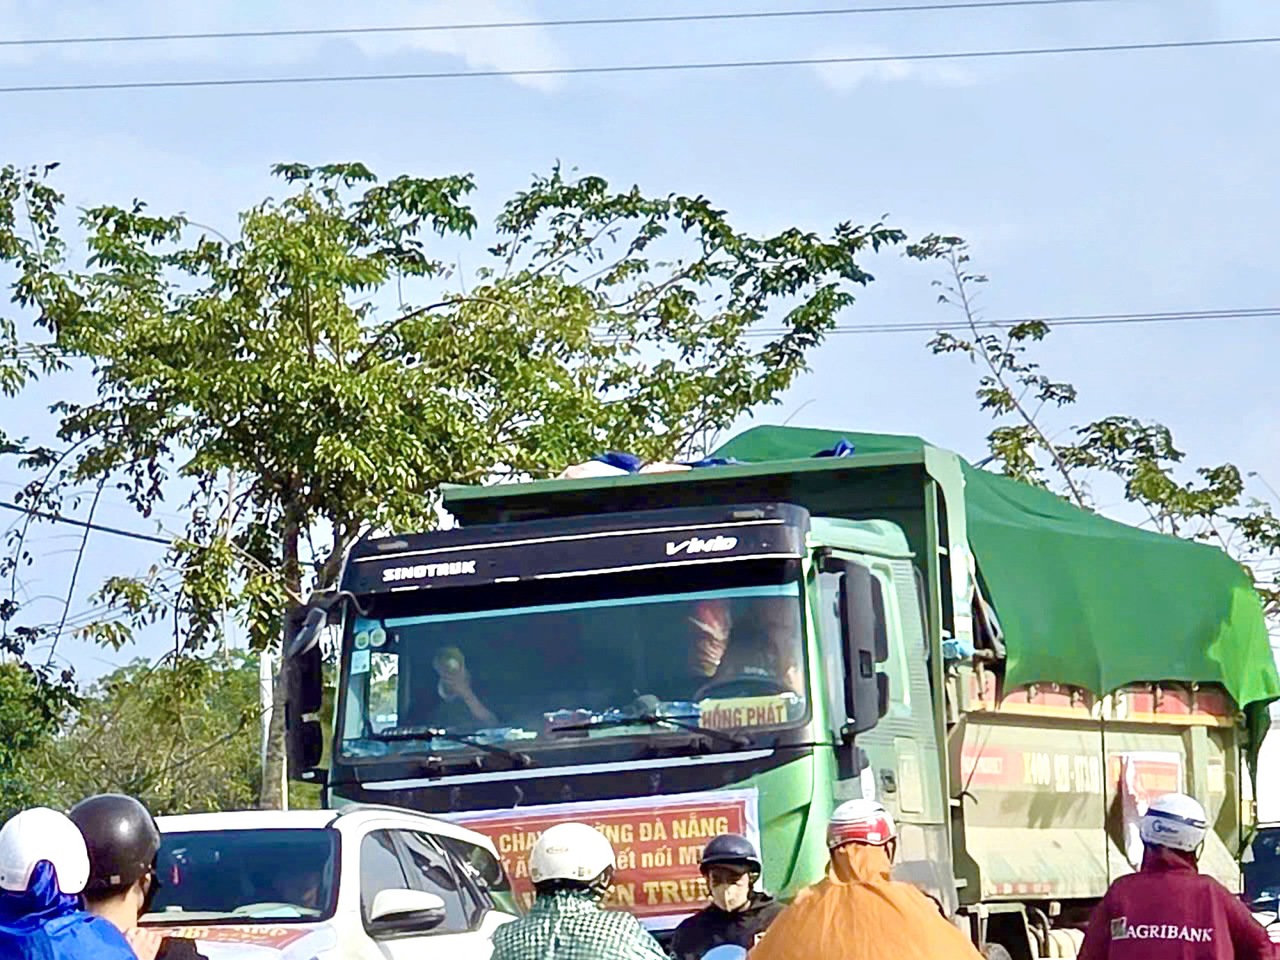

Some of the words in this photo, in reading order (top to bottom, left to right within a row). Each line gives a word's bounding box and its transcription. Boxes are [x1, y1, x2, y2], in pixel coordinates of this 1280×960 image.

[382, 560, 476, 582] SINOTRUK
[639, 817, 668, 842] ĐÀ
[641, 845, 673, 868] nối
[1127, 924, 1214, 942] AGRIBANK
